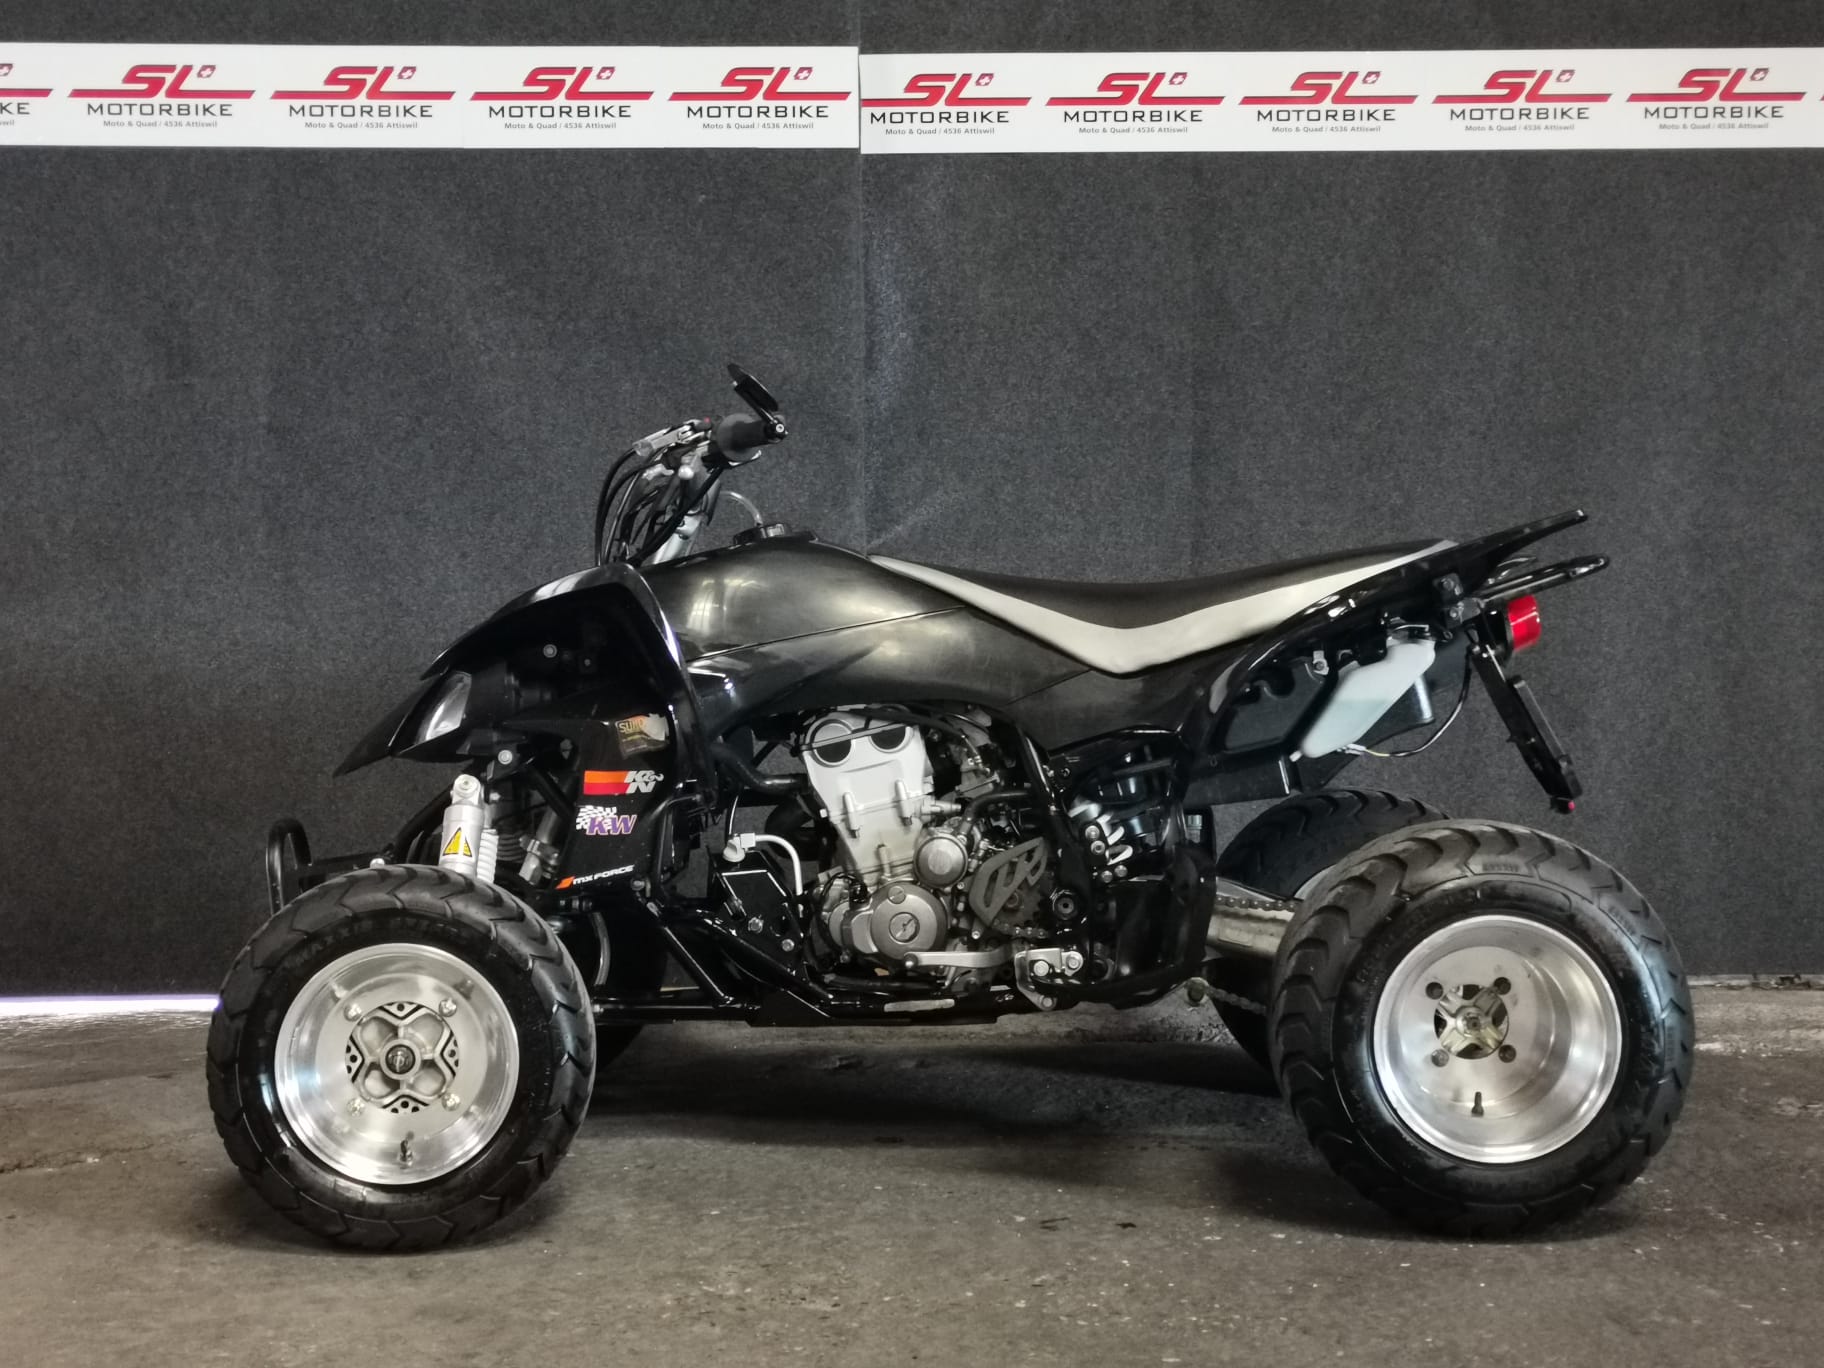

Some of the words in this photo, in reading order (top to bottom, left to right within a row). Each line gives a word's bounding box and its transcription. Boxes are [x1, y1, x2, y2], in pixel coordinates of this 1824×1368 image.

[87, 102, 233, 117] MOTORBIKE
[288, 104, 433, 118] MOTORBIKE
[488, 105, 632, 119] MOTORBIKE
[686, 105, 830, 119] MOTORBIKE
[1063, 109, 1204, 123] MOTORBIKE
[1256, 108, 1396, 122] MOTORBIKE
[1449, 107, 1590, 121] MOTORBIKE
[1644, 105, 1785, 119] MOTORBIKE
[102, 119, 126, 128] Moto
[135, 119, 158, 128] Quad
[870, 110, 1010, 124] MOTORBIKE
[304, 121, 327, 129] Moto
[336, 121, 359, 129] Quad
[504, 122, 527, 130] Moto
[535, 122, 558, 130] Quad
[702, 122, 724, 130] Moto
[734, 122, 756, 130] Quad
[884, 127, 907, 136] Moto
[916, 127, 937, 136] Quad
[1078, 126, 1101, 134] Moto
[1109, 126, 1131, 134] Quad
[1271, 125, 1294, 133] Moto
[1301, 125, 1324, 133] Quad
[586, 815, 638, 835] KW
[593, 864, 635, 880] FORCE
